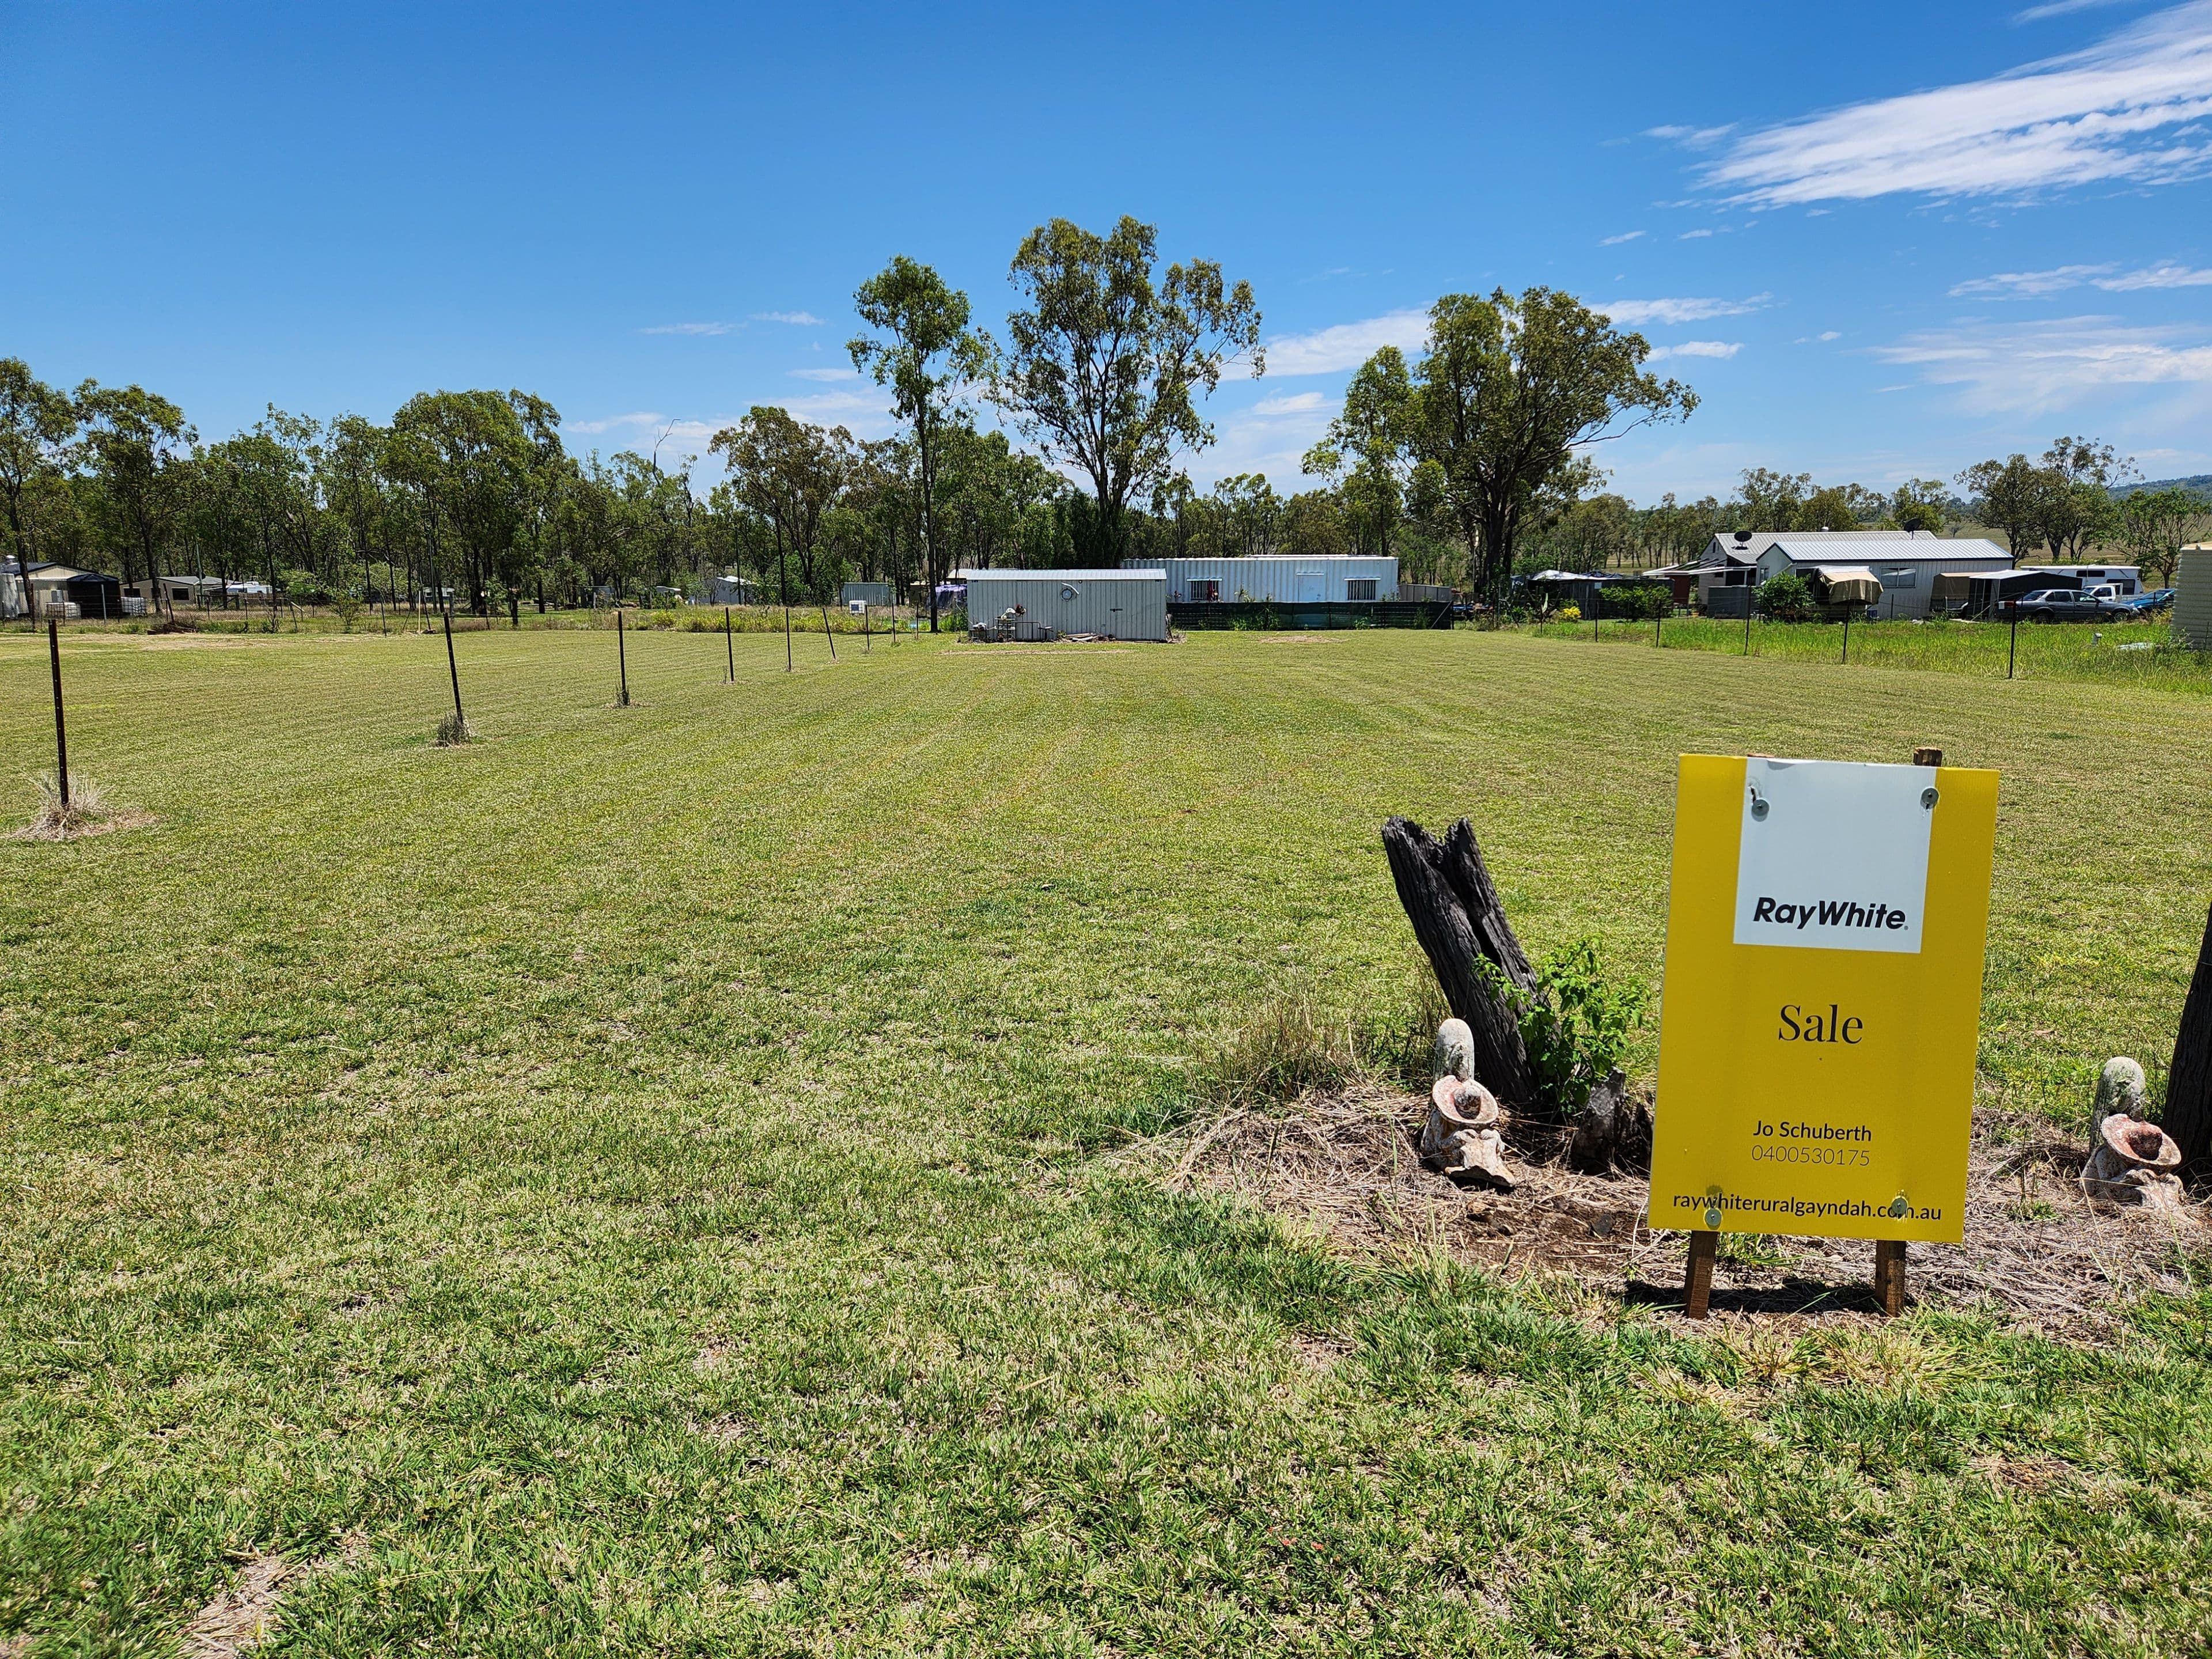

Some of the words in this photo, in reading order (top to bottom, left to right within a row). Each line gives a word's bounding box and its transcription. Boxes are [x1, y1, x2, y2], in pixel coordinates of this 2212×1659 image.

[1778, 1004, 1863, 1044] Sale
[1753, 1120, 1774, 1137] Jo
[1779, 1121, 1872, 1142] Schuberth
[1752, 1145, 1870, 1166] 0400530175
